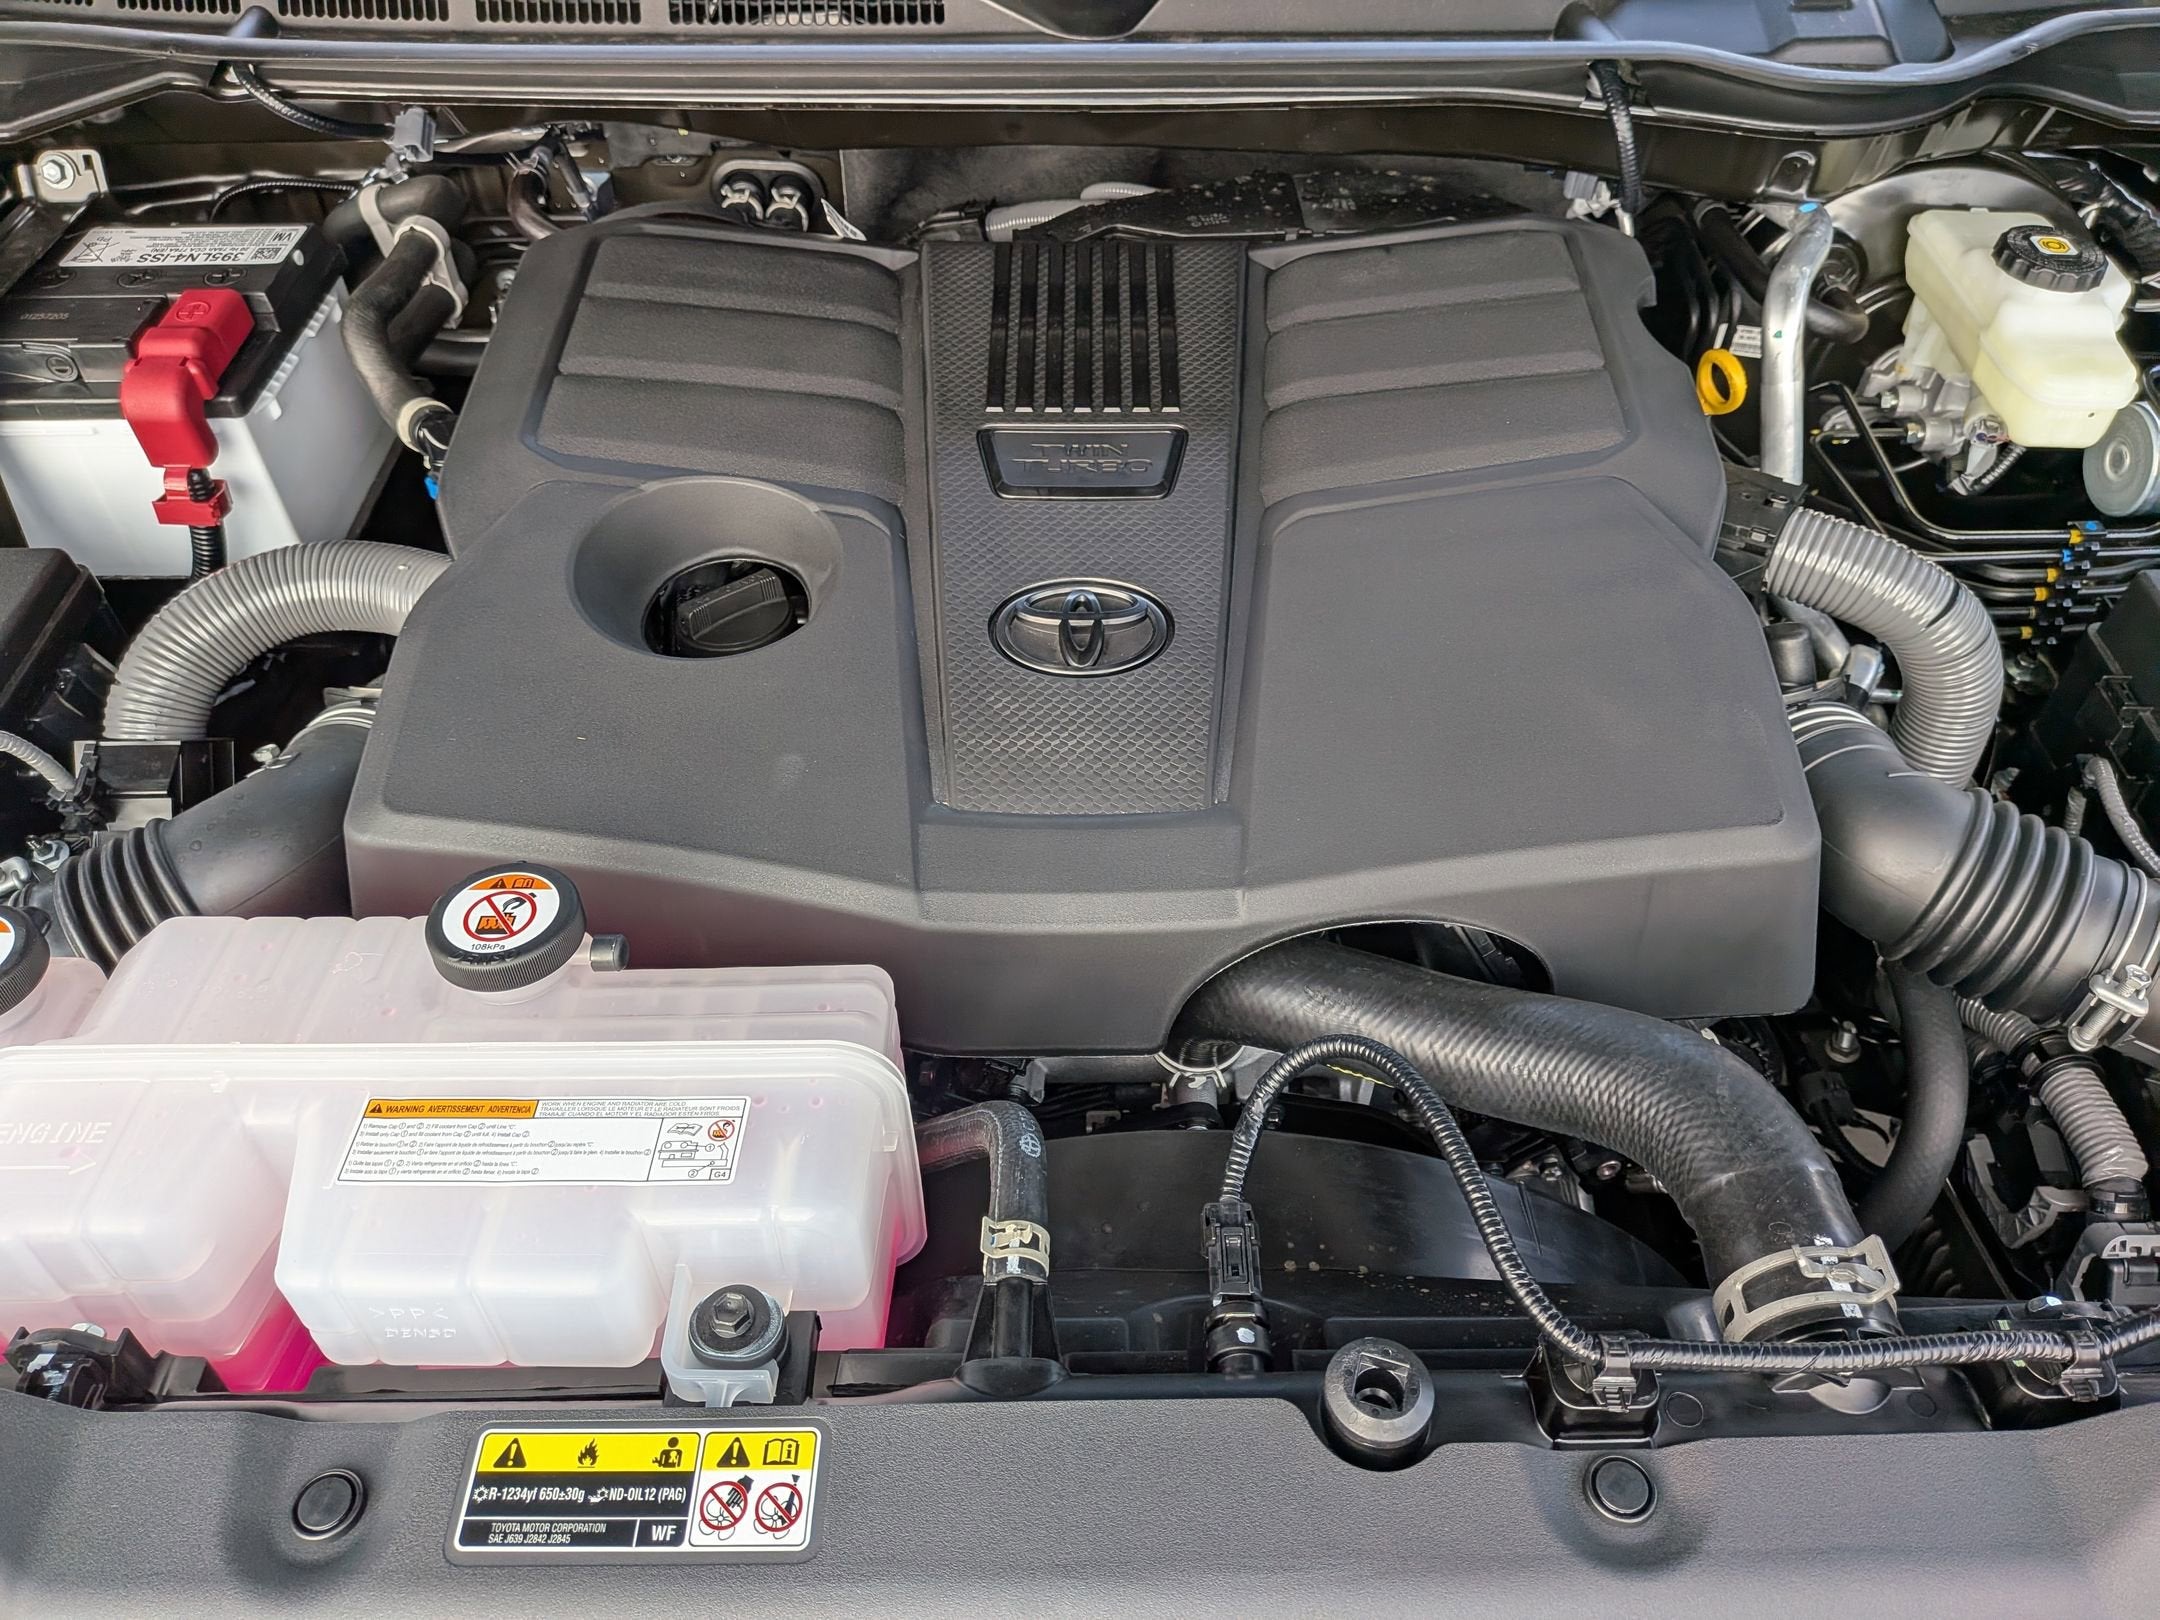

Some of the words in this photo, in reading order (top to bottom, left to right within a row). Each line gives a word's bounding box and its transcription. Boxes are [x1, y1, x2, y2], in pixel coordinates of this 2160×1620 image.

[273, 232, 292, 241] VM
[137, 252, 244, 263] 395LN4-ISS
[1031, 443, 1129, 456] TWIN
[1011, 458, 1153, 473] TURBO
[471, 943, 506, 951] 108kPa
[386, 1105, 425, 1113] WARNING
[428, 1105, 485, 1113] AVERTISSEMENT
[488, 1105, 531, 1113] ADVERTENCIA
[385, 1328, 456, 1338] DENSO
[488, 1486, 538, 1502] R-1234yf
[539, 1486, 585, 1502] 650±30g
[608, 1487, 656, 1502] ND-OIL12
[657, 1487, 687, 1502] (PAG)
[491, 1523, 521, 1533] TOYOTA
[522, 1523, 551, 1533] MOTOR
[552, 1523, 606, 1533] CORPORATION
[652, 1525, 676, 1541] WF
[488, 1533, 503, 1544] SAE
[504, 1533, 523, 1544] J639
[524, 1533, 546, 1544] J2842
[547, 1533, 571, 1544] J2845
